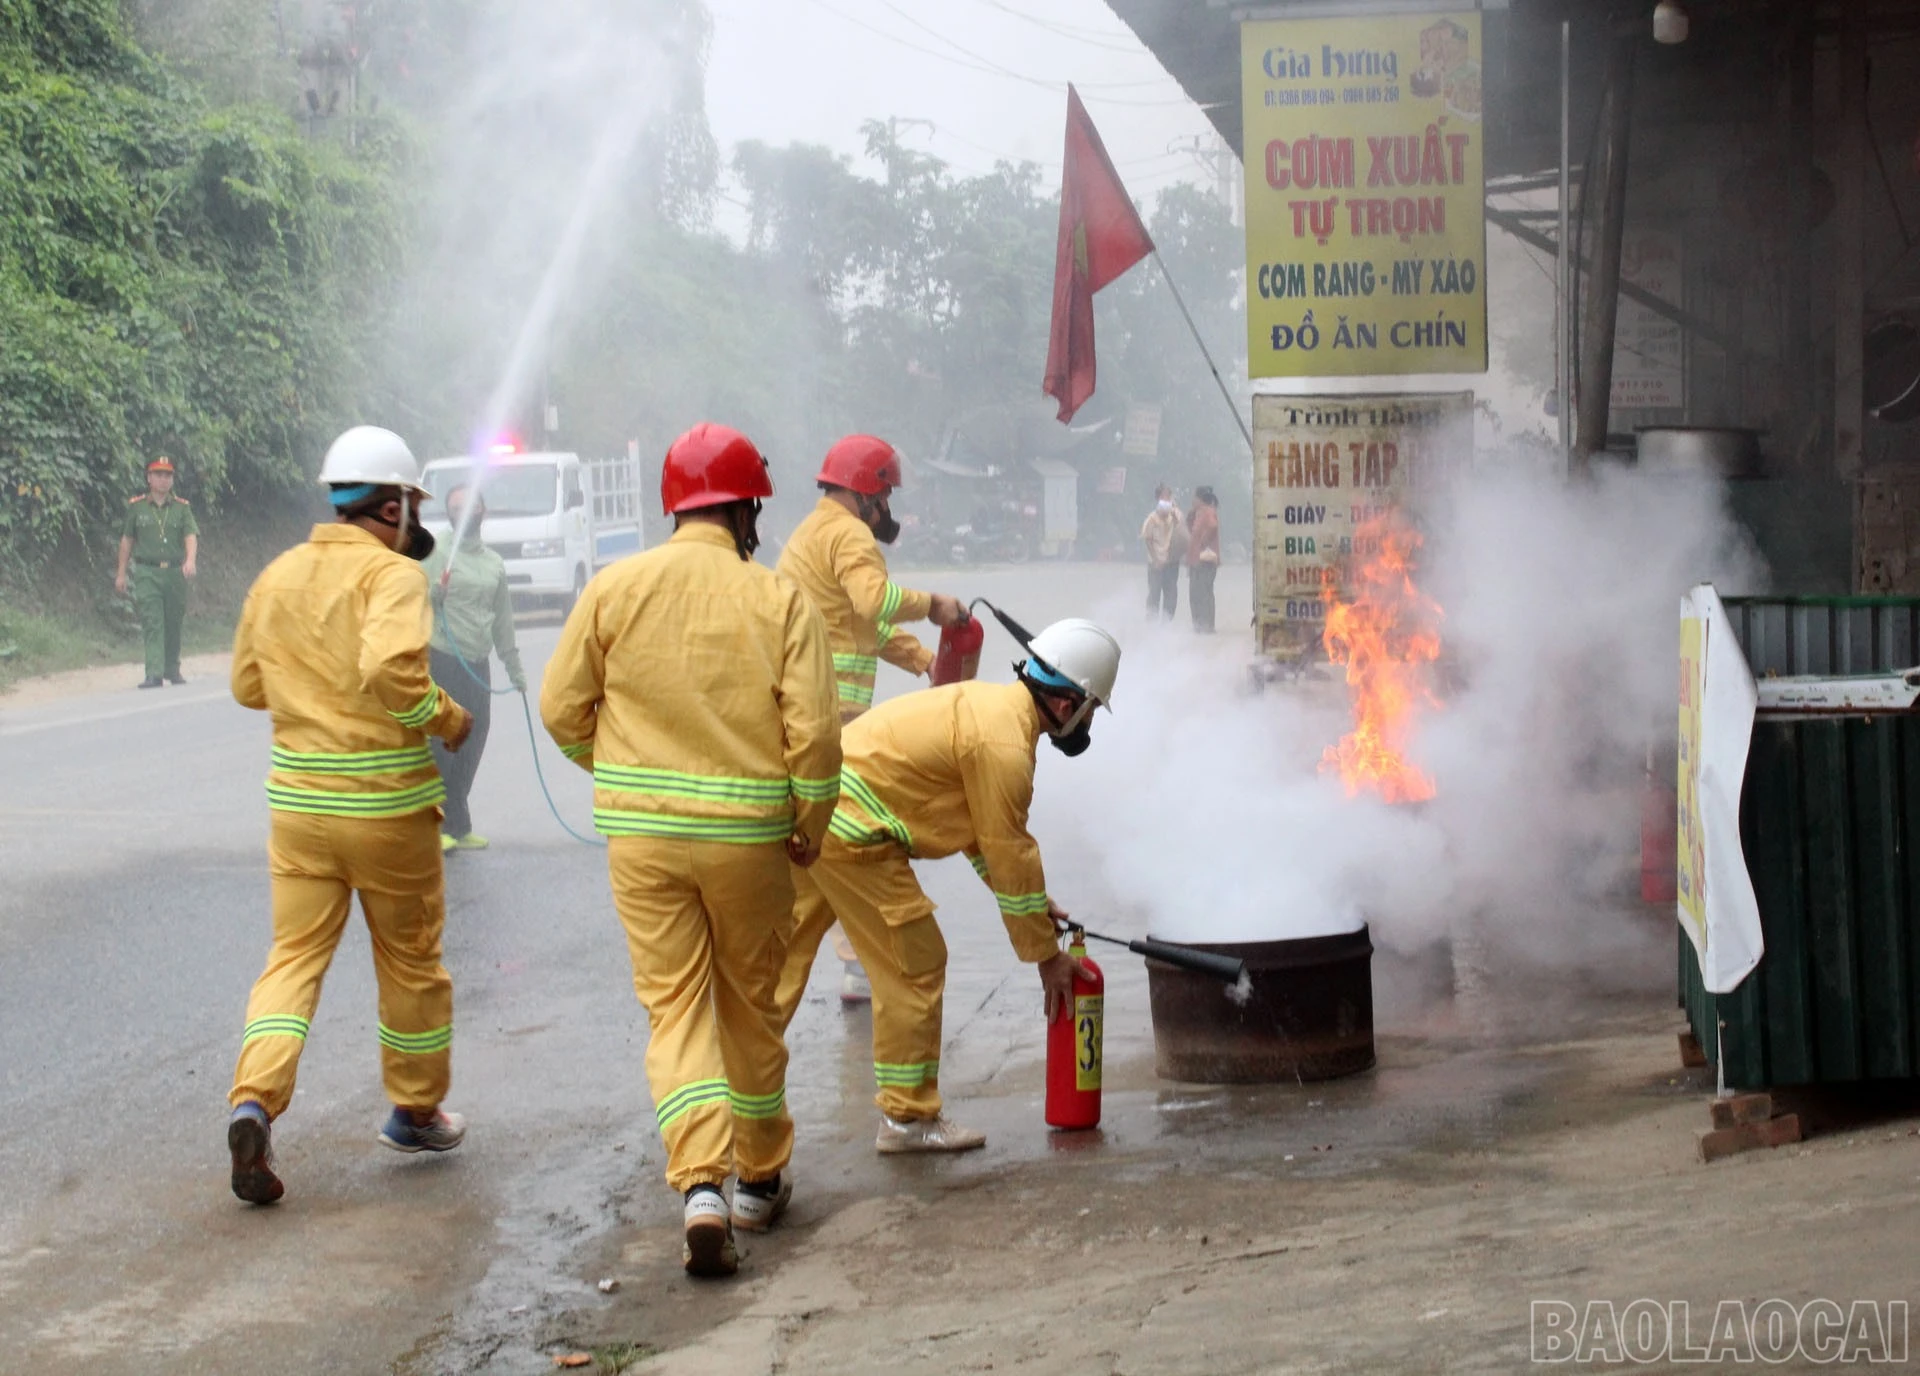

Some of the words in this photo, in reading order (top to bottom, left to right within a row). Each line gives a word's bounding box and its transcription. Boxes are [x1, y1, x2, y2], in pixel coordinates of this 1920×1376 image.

[1263, 47, 1310, 80] Gia
[1265, 133, 1355, 190] CƠM
[1367, 116, 1469, 187] XUẤT
[1288, 196, 1339, 247] TỰ
[1345, 196, 1446, 244] TRỌN
[1314, 261, 1375, 297] RANG
[1430, 252, 1476, 294] XÀO
[1271, 309, 1320, 351] ĐỒ
[1332, 315, 1377, 349] ĂN
[1390, 310, 1466, 349] CHÍN
[1285, 536, 1316, 555] BIA
[1079, 1017, 1095, 1072] 3
